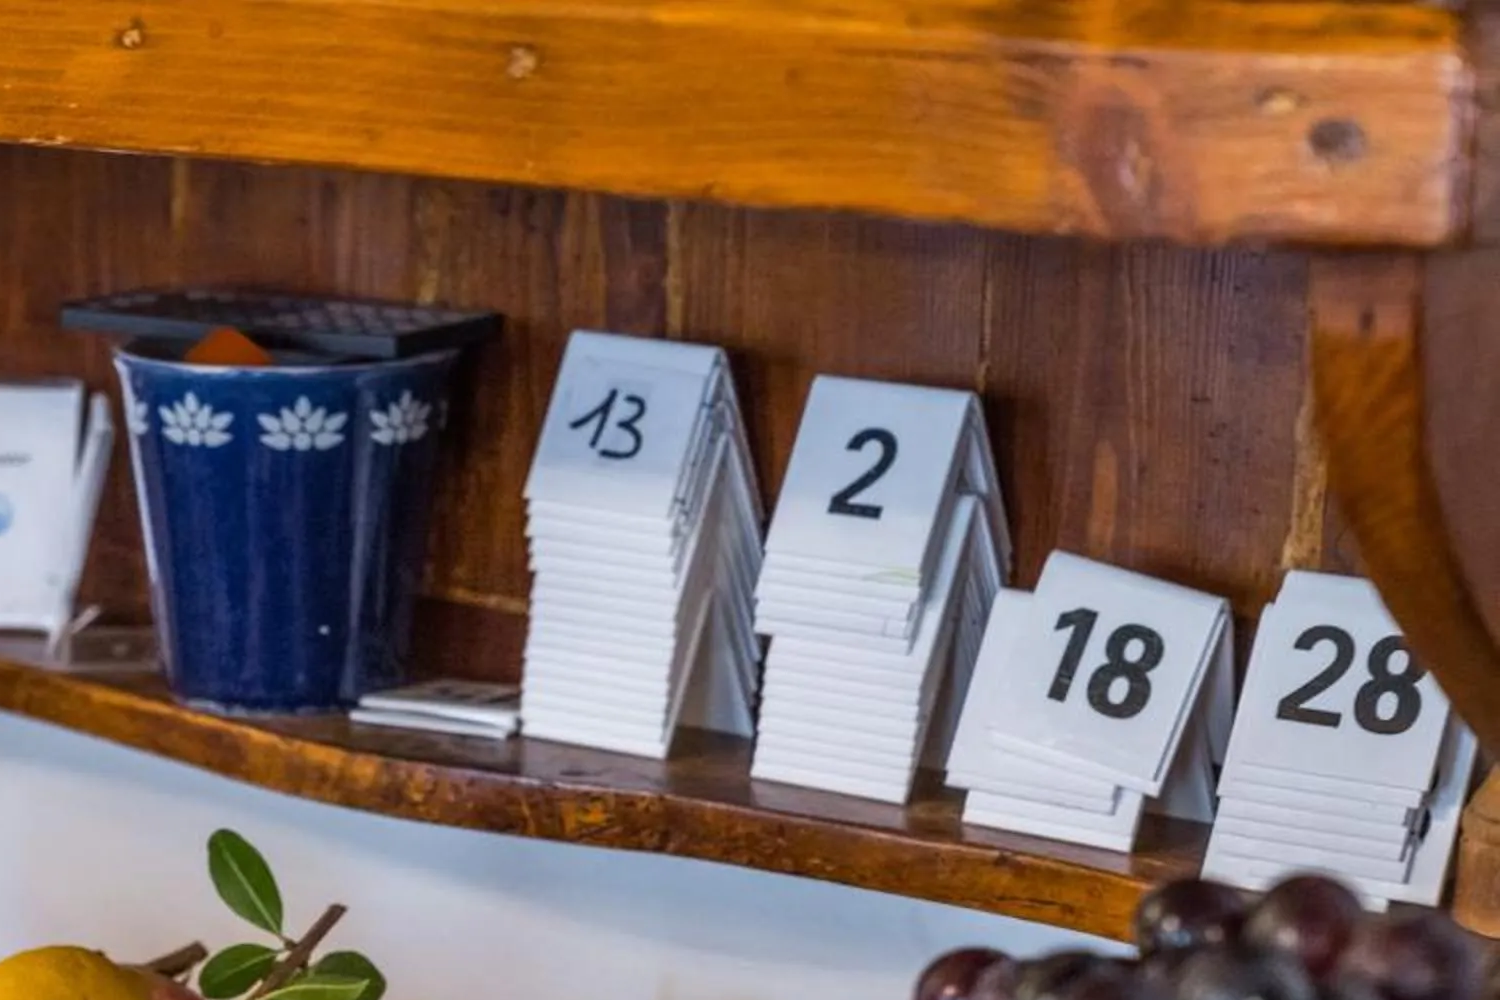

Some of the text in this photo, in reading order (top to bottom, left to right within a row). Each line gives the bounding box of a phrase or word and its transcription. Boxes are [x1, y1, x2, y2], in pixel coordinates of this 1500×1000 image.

[569, 388, 647, 459] 13
[827, 427, 899, 520] 2
[1046, 607, 1165, 720] 18
[1275, 625, 1426, 735] 28
